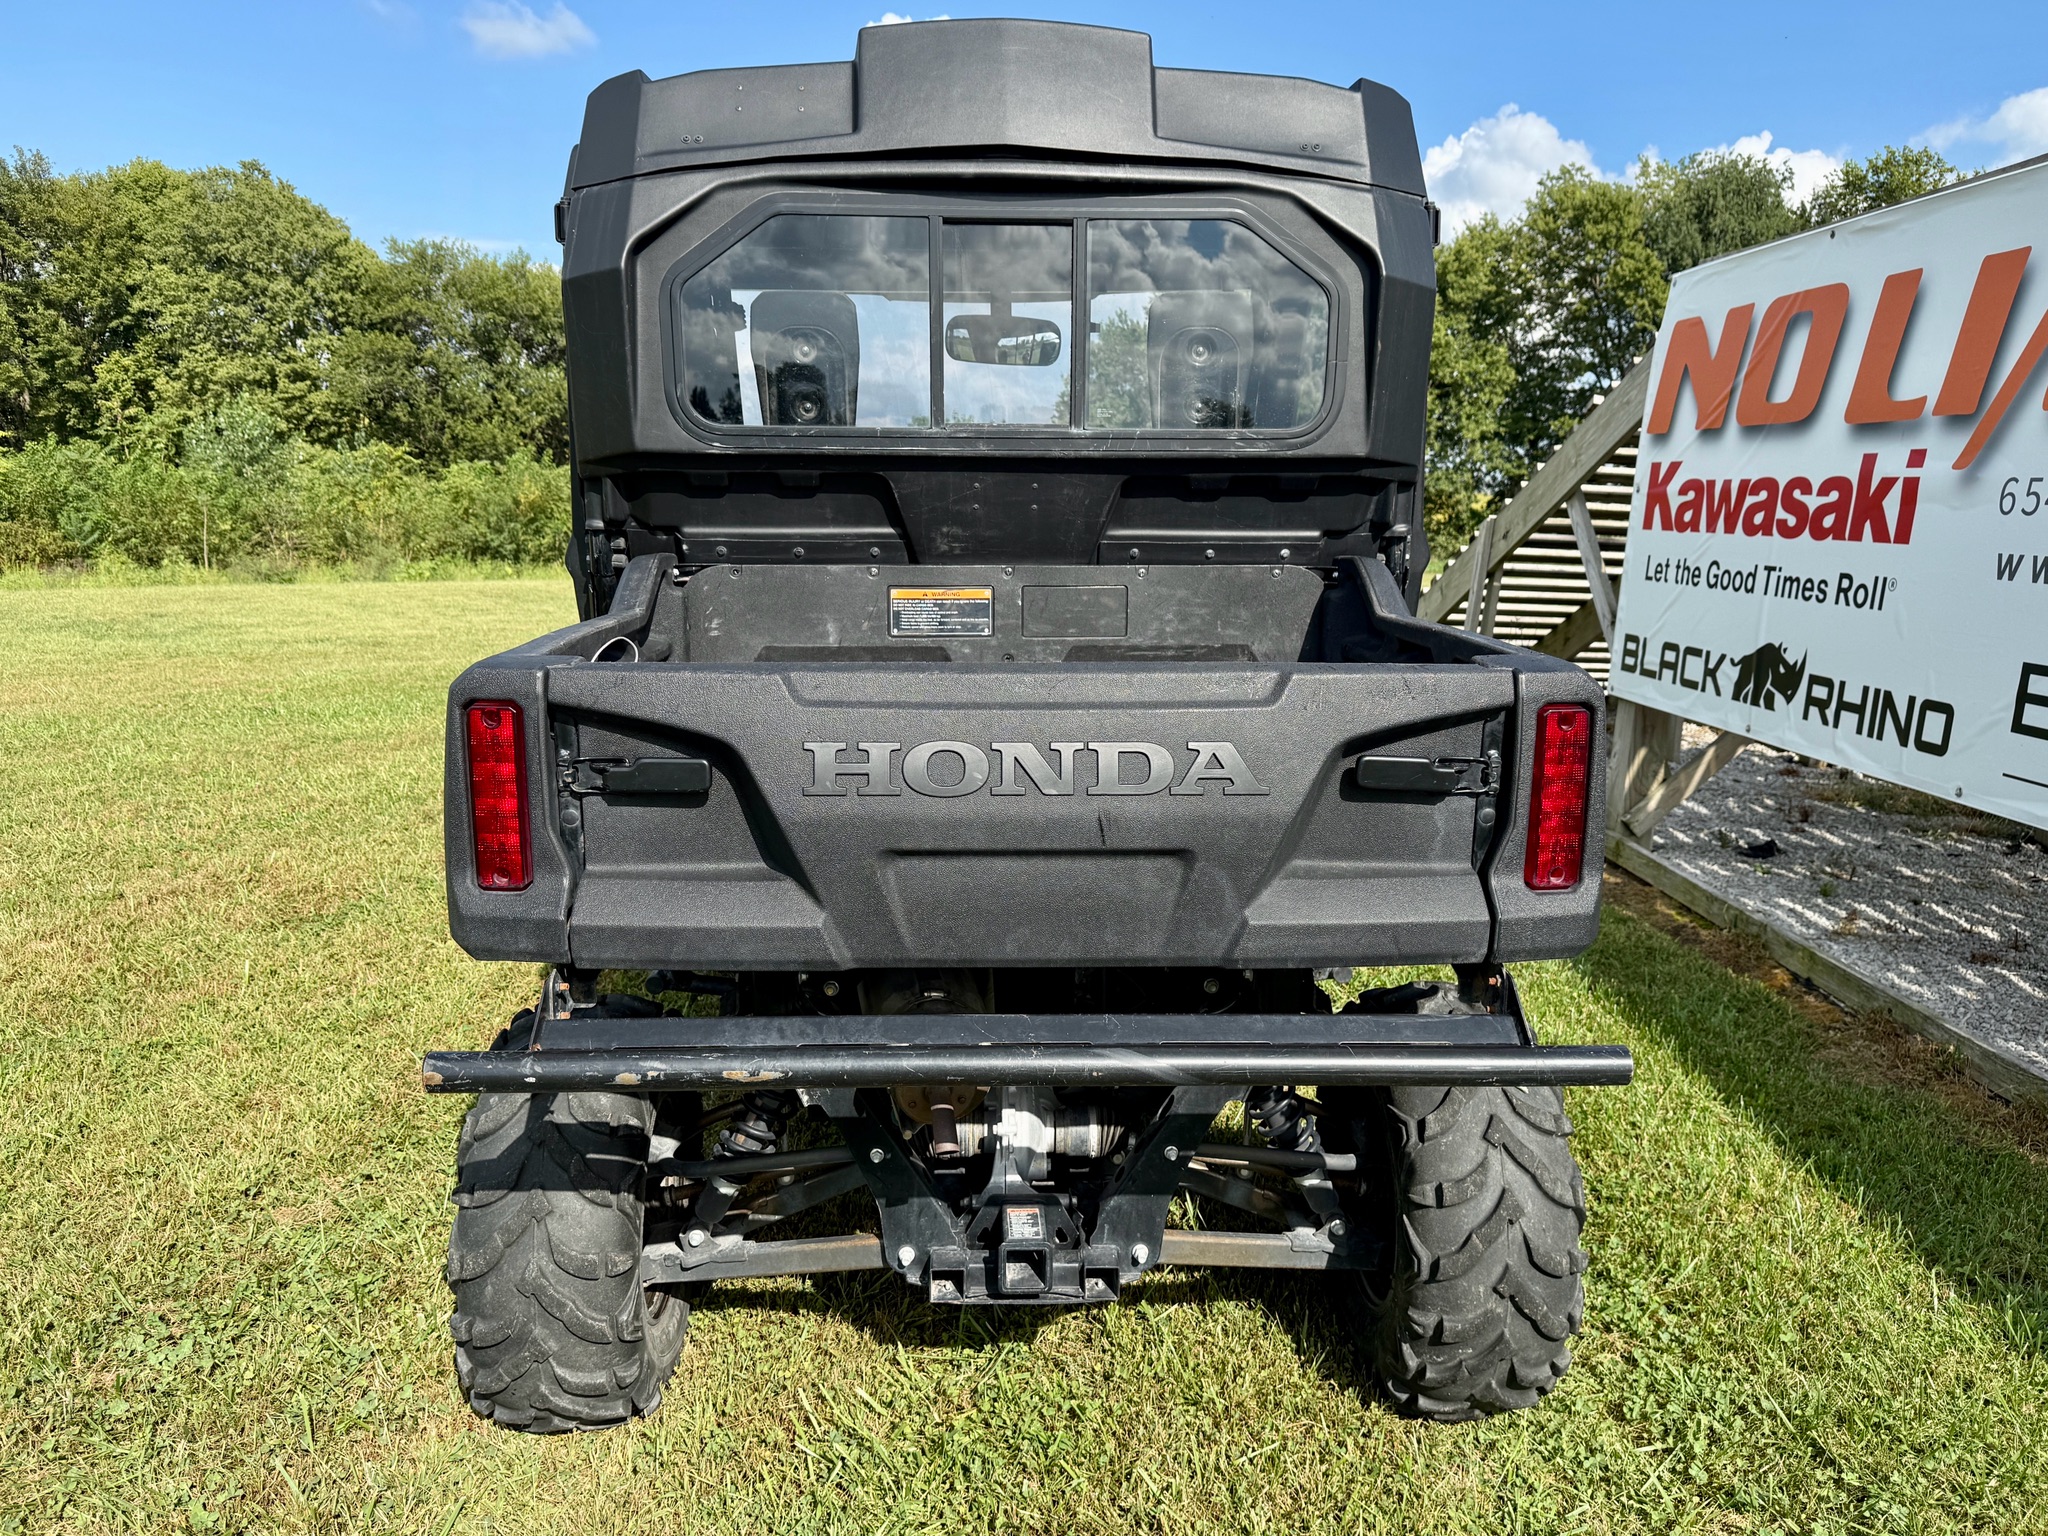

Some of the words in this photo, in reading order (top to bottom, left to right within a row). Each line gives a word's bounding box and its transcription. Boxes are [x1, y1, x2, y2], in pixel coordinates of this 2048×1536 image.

[1642, 448, 1928, 545] Kawasaki
[1645, 555, 1670, 583] Let
[1675, 558, 1701, 587] the
[1706, 560, 1758, 594] Good
[1764, 565, 1828, 604] Times
[1620, 633, 1727, 697] BLACK
[1802, 673, 1955, 757] RHINO
[802, 740, 1271, 798] HONDA
